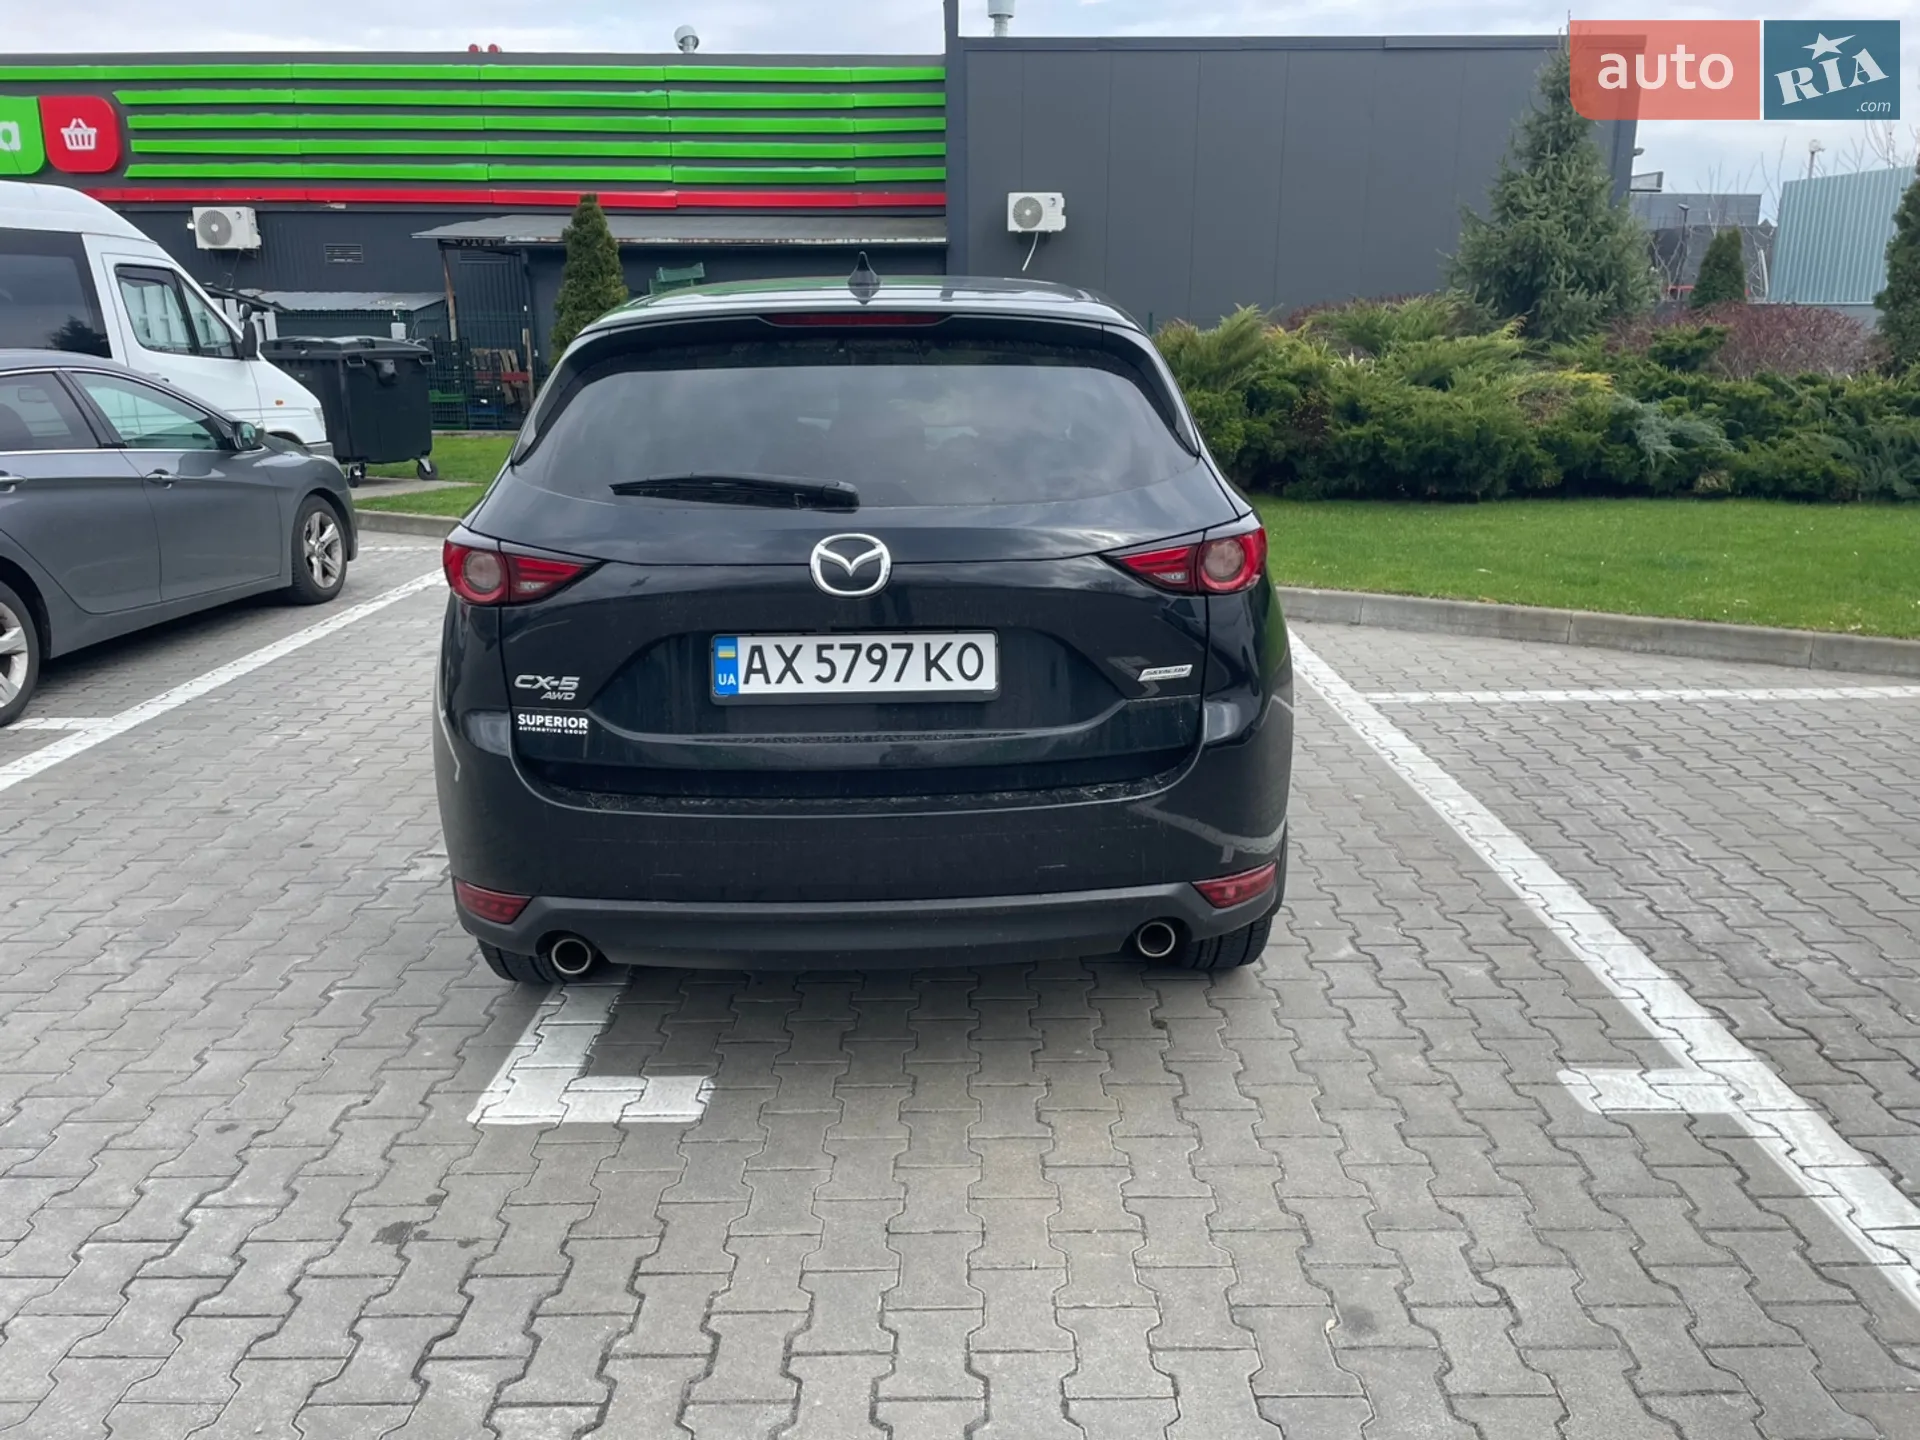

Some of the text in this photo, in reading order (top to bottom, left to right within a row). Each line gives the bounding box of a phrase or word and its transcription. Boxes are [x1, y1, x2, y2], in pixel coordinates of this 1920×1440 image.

[743, 641, 984, 685] AX 5797 KO
[514, 674, 580, 691] CX-5
[718, 673, 737, 686] UA
[540, 691, 576, 701] AWD
[517, 713, 589, 729] SUPERIOR
